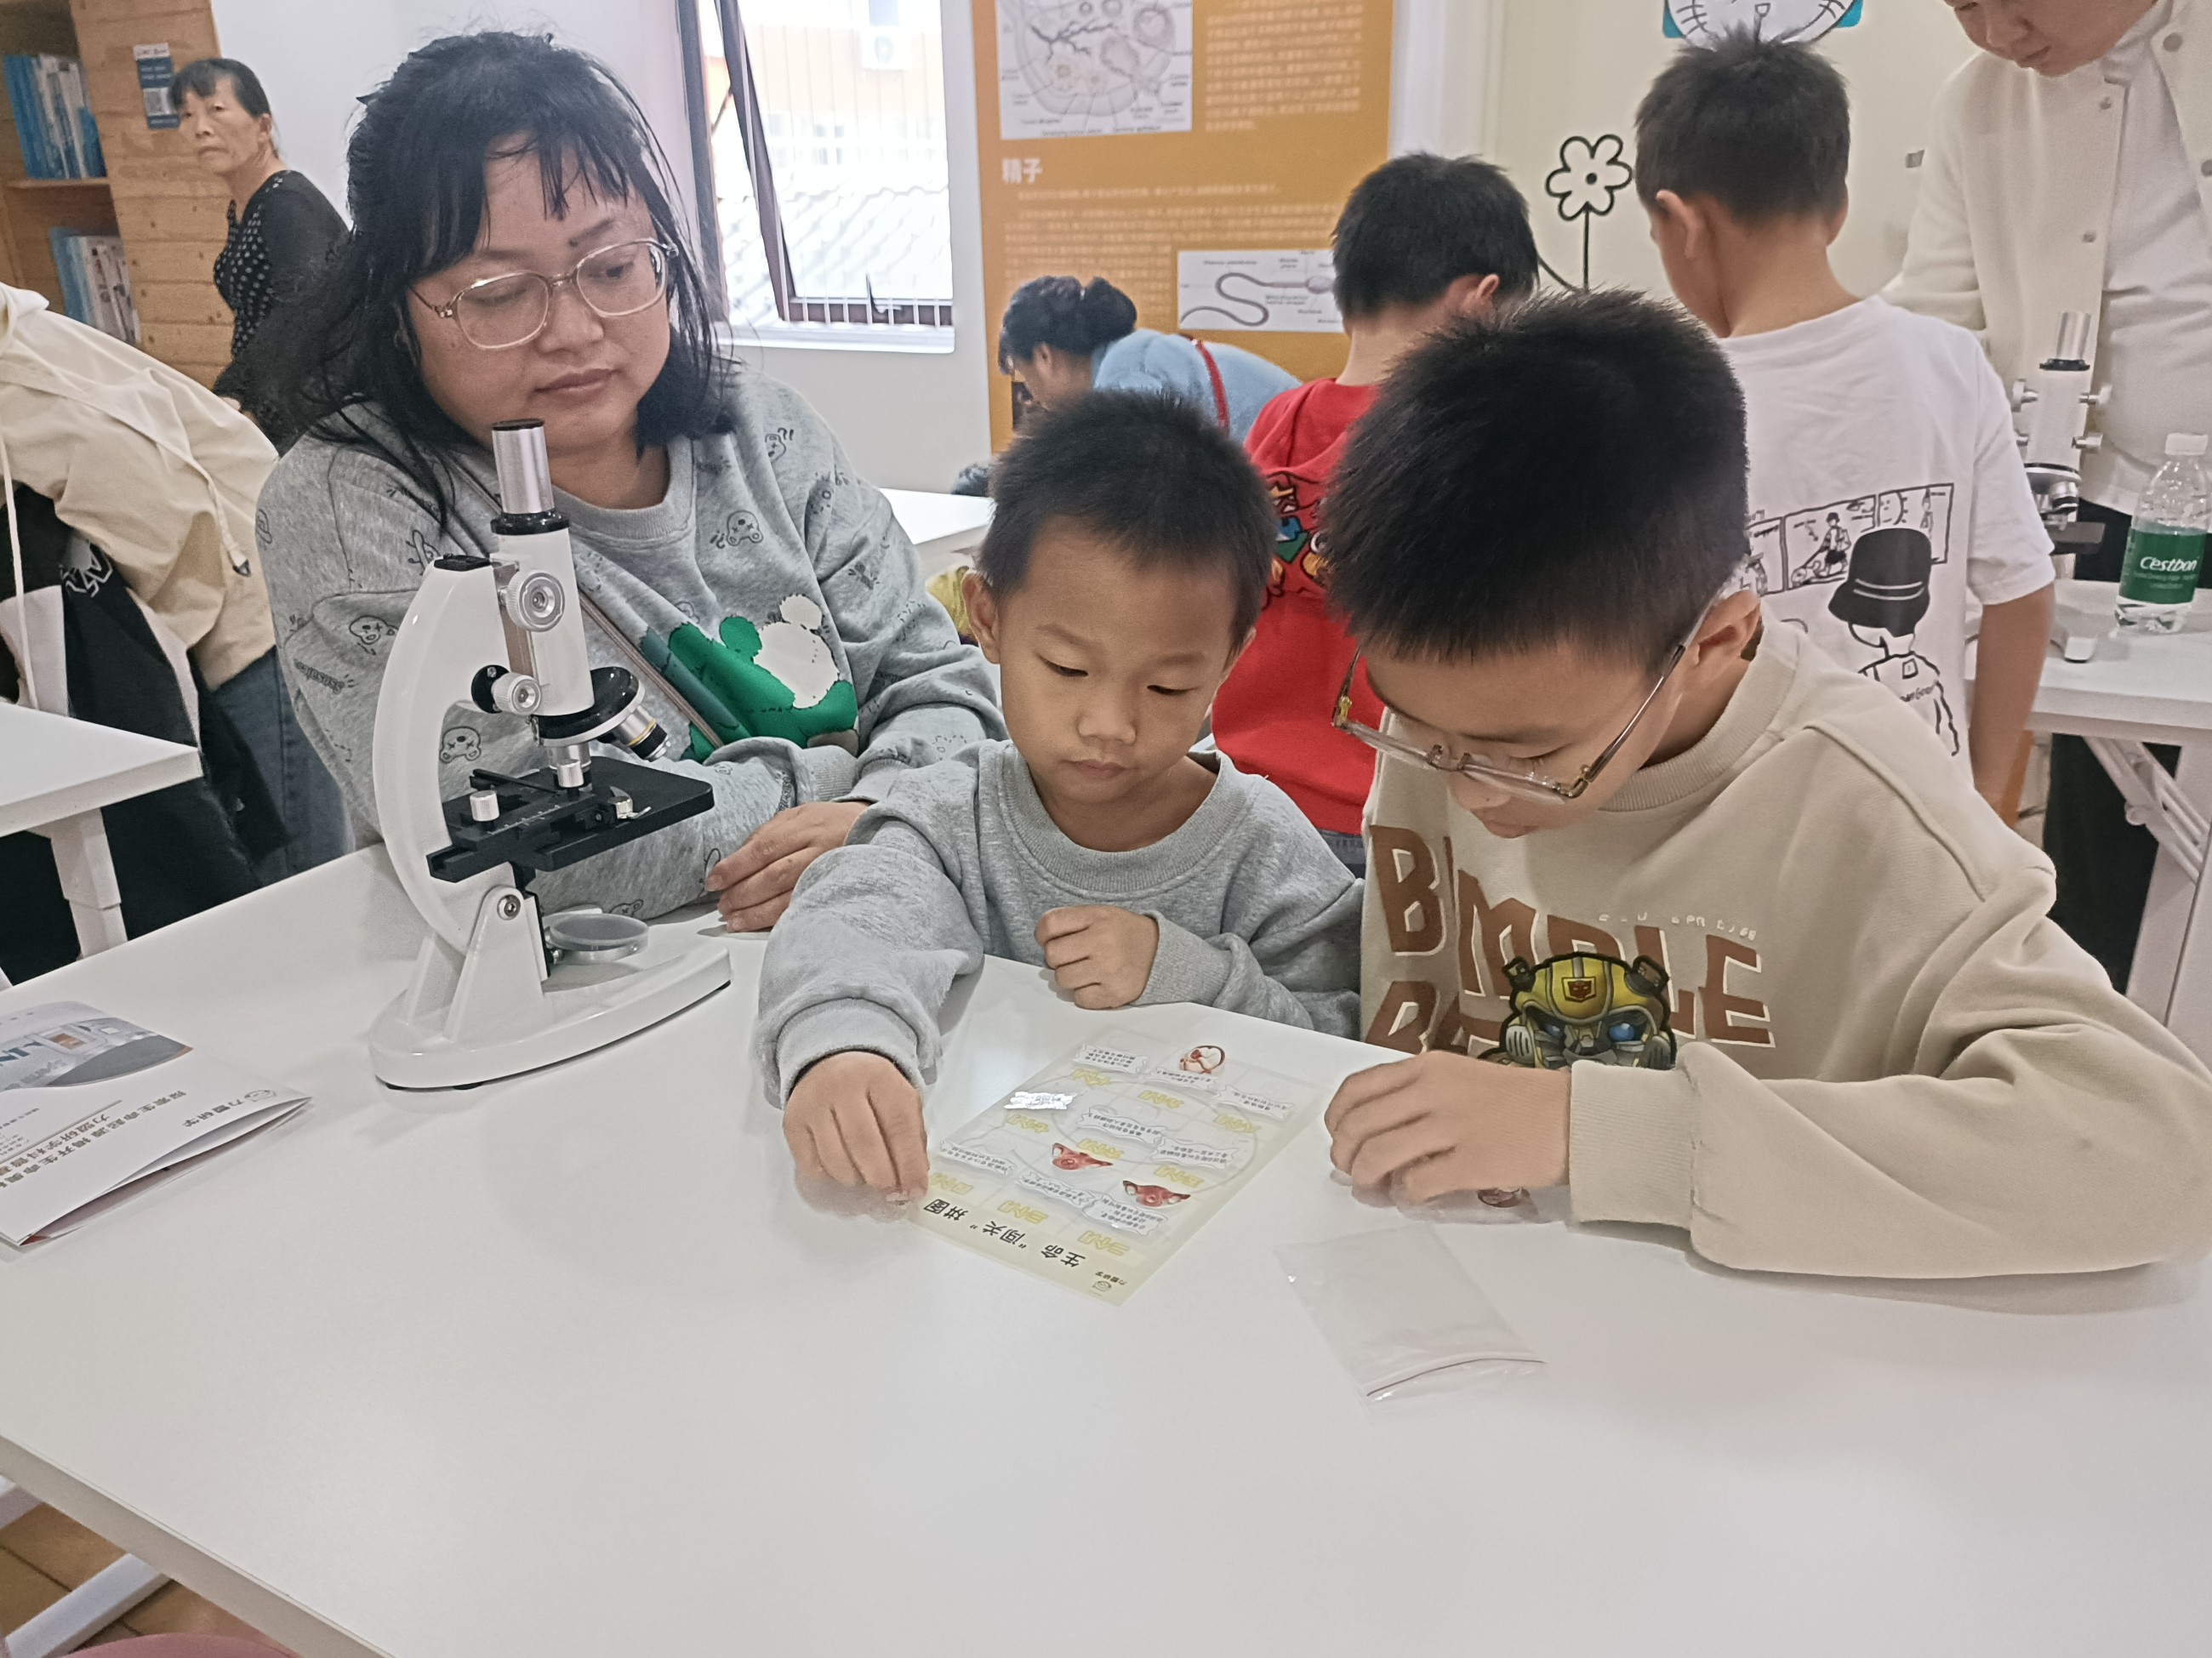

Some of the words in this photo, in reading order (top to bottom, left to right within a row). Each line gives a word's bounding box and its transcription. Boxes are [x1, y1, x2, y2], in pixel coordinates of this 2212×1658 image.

[1369, 824, 1776, 1048] BMLE
[1137, 1090, 1185, 1109] 九个月
[1077, 1138, 1125, 1159] 六个月
[1154, 1165, 1206, 1188] 五个月
[997, 1199, 1049, 1224] 三个月
[1078, 1230, 1131, 1256] 二个月
